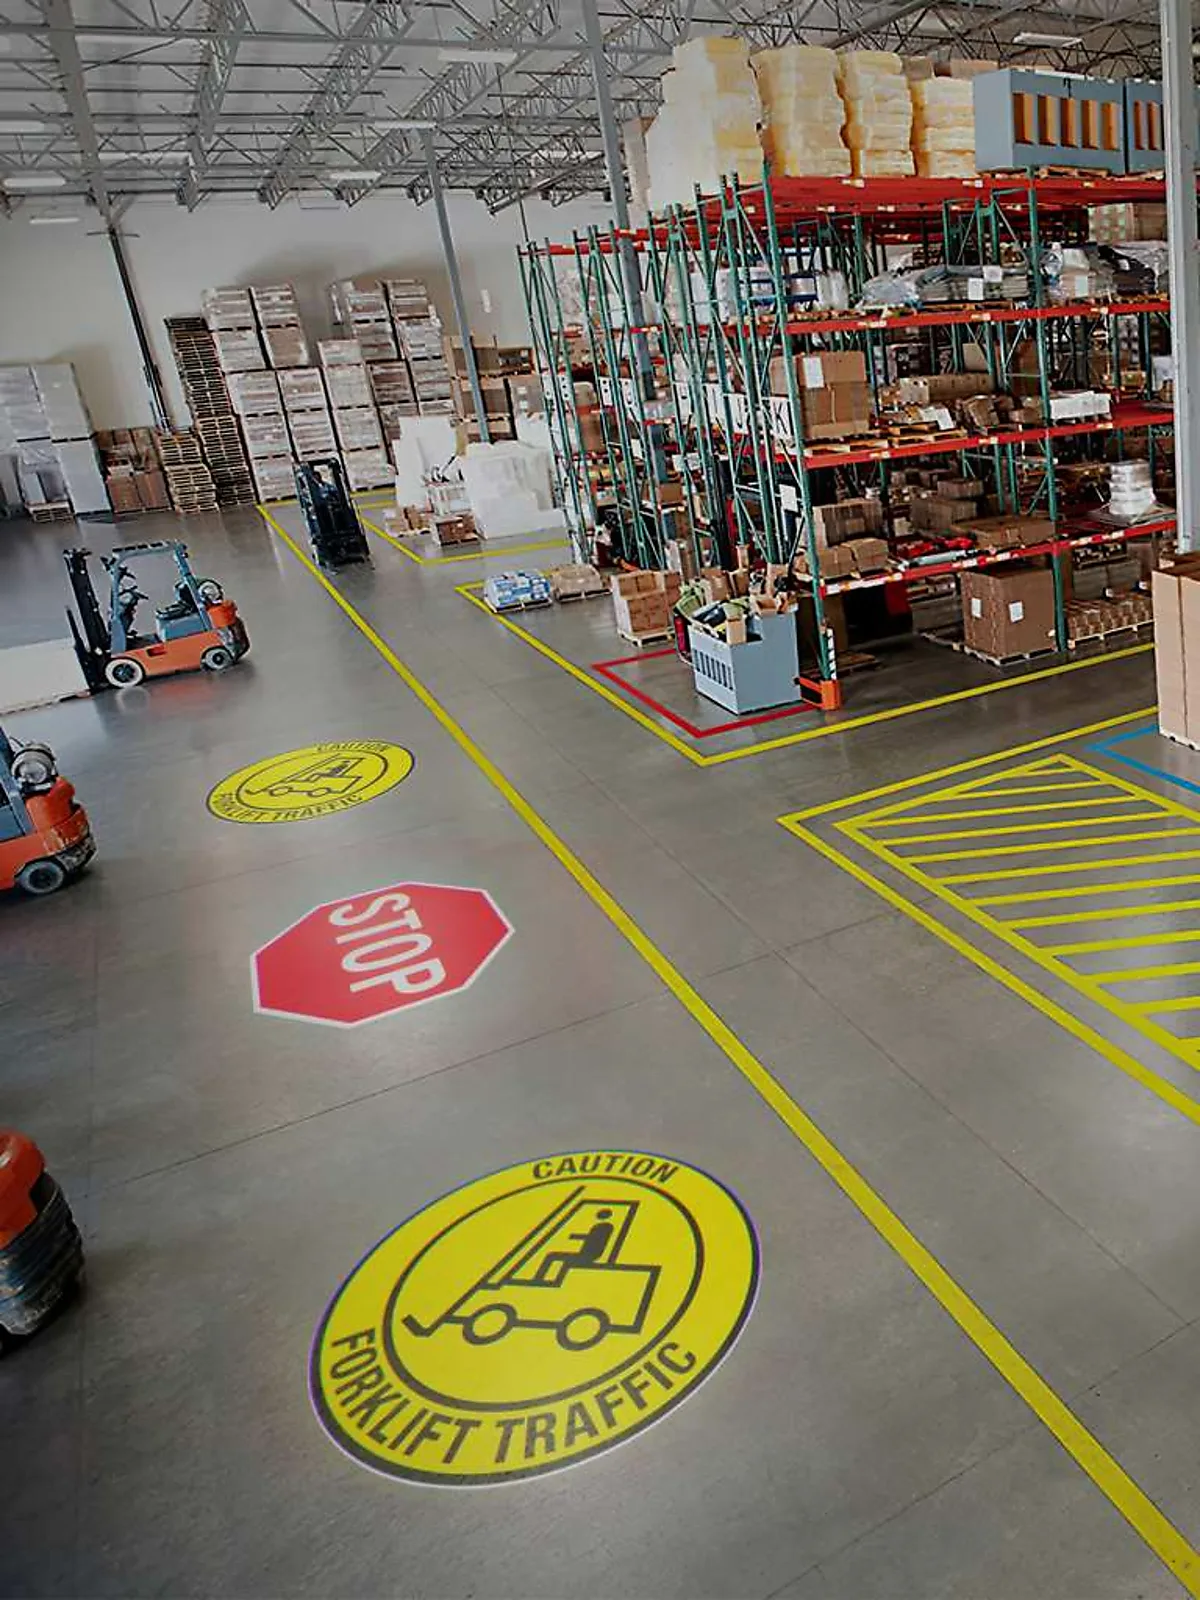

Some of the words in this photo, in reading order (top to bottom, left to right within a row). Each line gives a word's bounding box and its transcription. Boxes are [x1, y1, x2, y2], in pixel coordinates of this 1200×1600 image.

[773, 401, 788, 435] K
[272, 795, 364, 821] TRAFFIC
[328, 892, 446, 993] STOP
[532, 1154, 679, 1184] CAUTION
[329, 1327, 482, 1464] FORKLIFT
[493, 1341, 697, 1464] TRAFFIC
